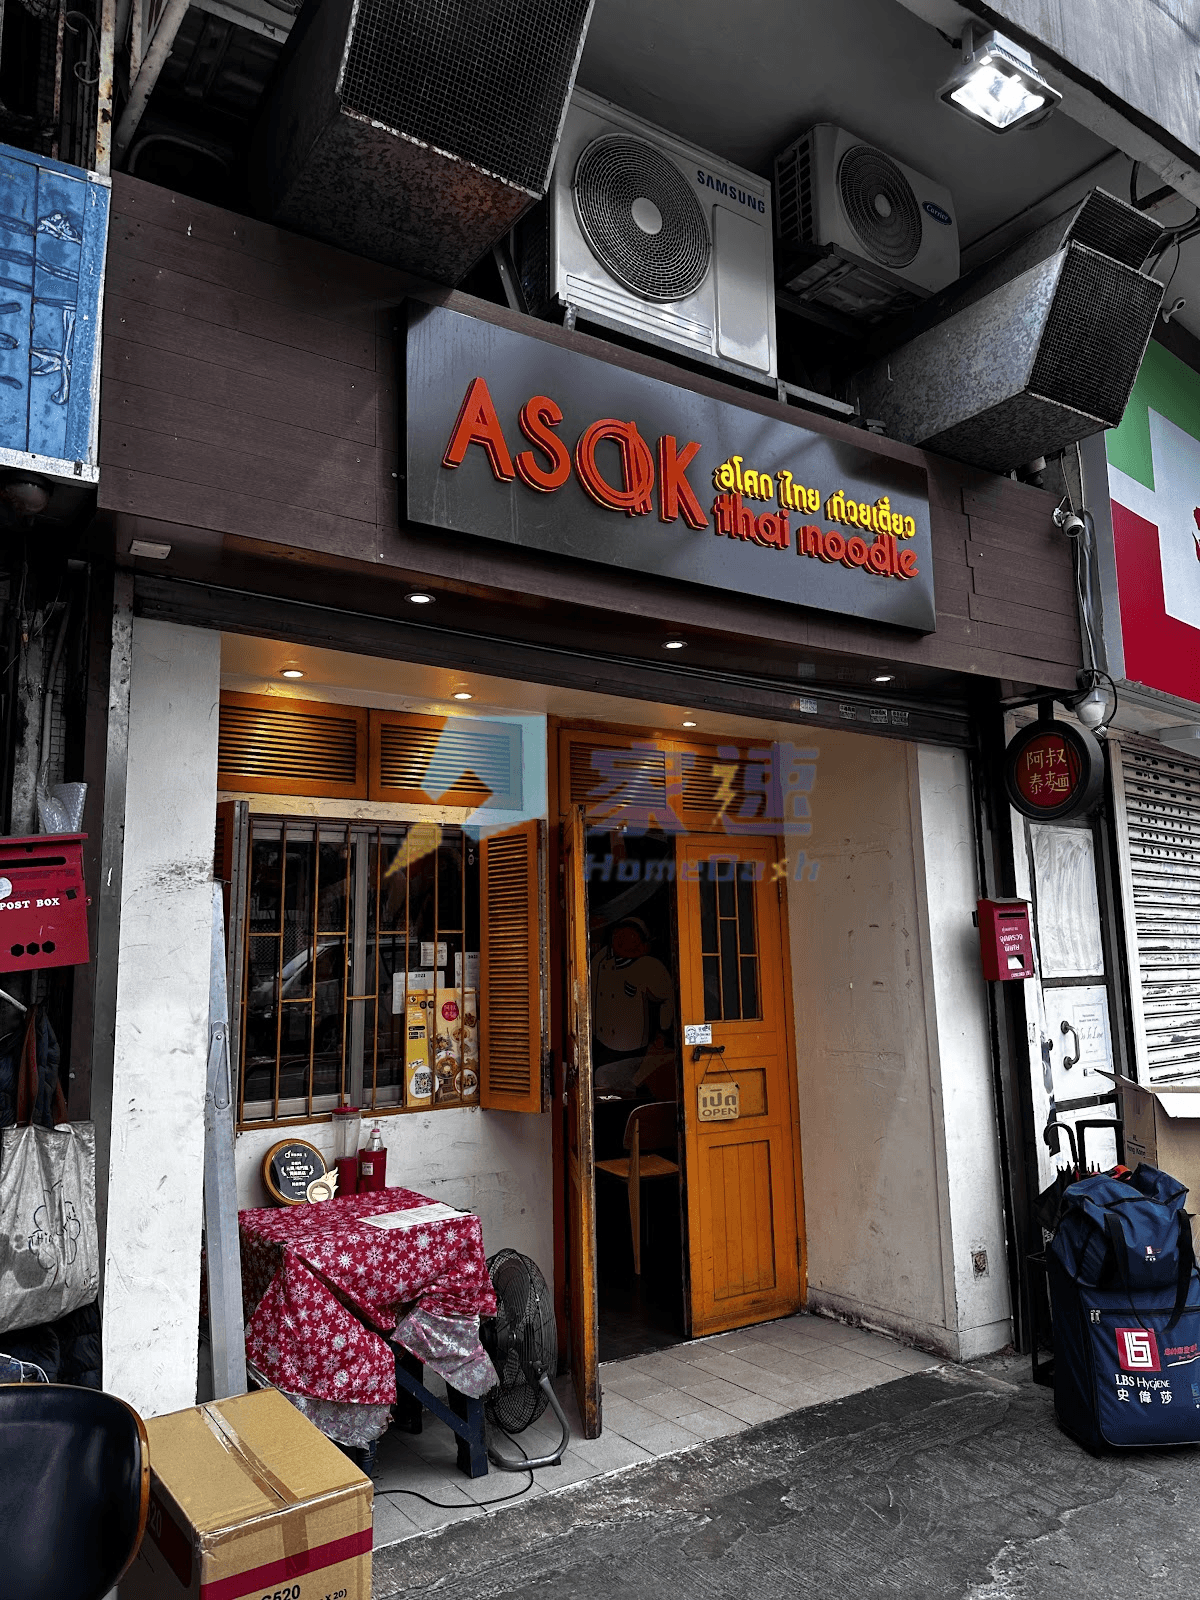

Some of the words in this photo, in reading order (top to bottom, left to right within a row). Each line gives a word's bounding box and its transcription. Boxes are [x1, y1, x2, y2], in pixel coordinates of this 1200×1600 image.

[697, 169, 766, 215] SAMSUNG
[925, 203, 949, 222] Carrier
[775, 470, 820, 515] ไทย
[711, 492, 791, 549] thai
[796, 524, 920, 580] noodle
[1026, 747, 1068, 771] 阿叔
[1028, 770, 1070, 795] 泰麵
[0, 900, 31, 911] POST
[36, 897, 61, 908] BOX
[702, 1088, 737, 1108] เปิด
[702, 1107, 738, 1117] OPEN
[1115, 1373, 1135, 1388] LBS
[1117, 1387, 1173, 1405] 史偉莎
